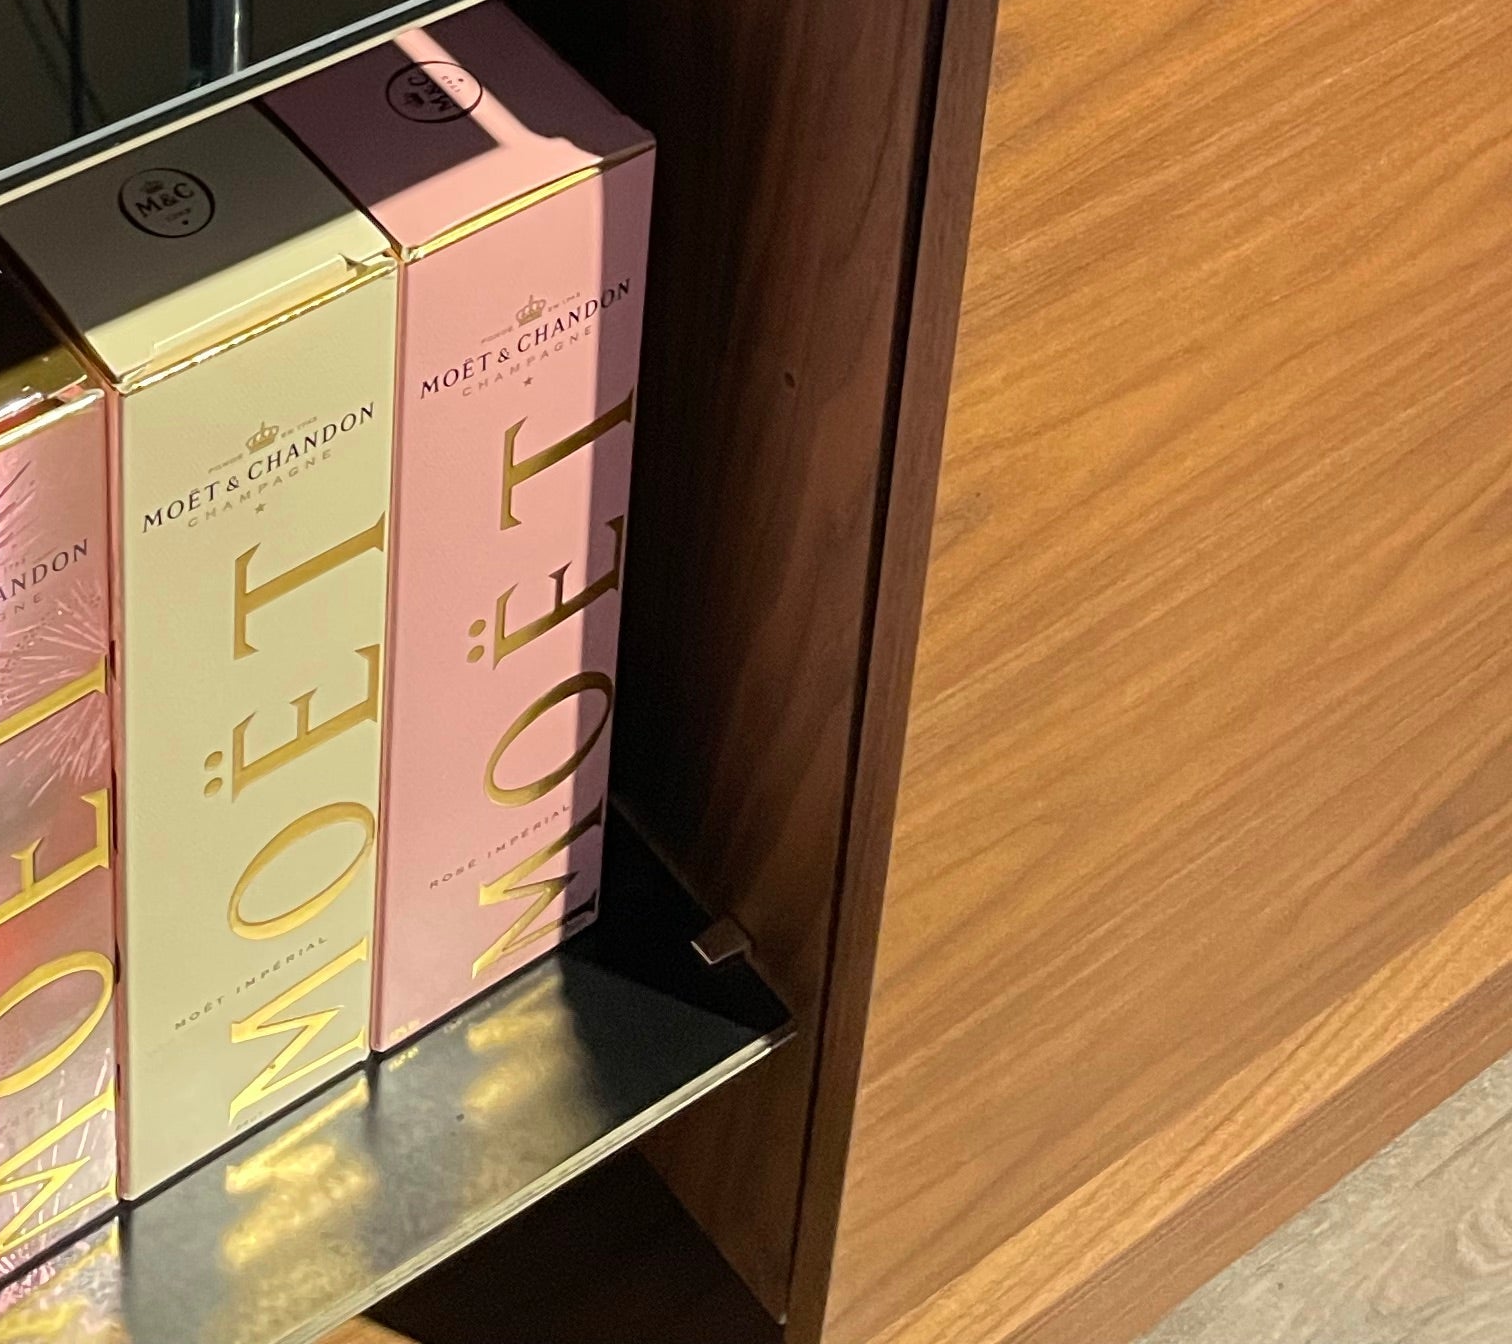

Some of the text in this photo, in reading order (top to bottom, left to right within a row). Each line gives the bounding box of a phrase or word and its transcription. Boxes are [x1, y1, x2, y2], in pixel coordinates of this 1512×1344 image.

[135, 182, 194, 218] M&C
[462, 324, 592, 397] CHAMPAGNE
[497, 347, 510, 363] &
[517, 278, 631, 354] CHANDON
[188, 449, 332, 528] CHAMPAGNE
[226, 475, 240, 492] &
[248, 401, 375, 481] CHANDON
[467, 386, 635, 980] MOËT
[203, 511, 388, 1127] MOËT
